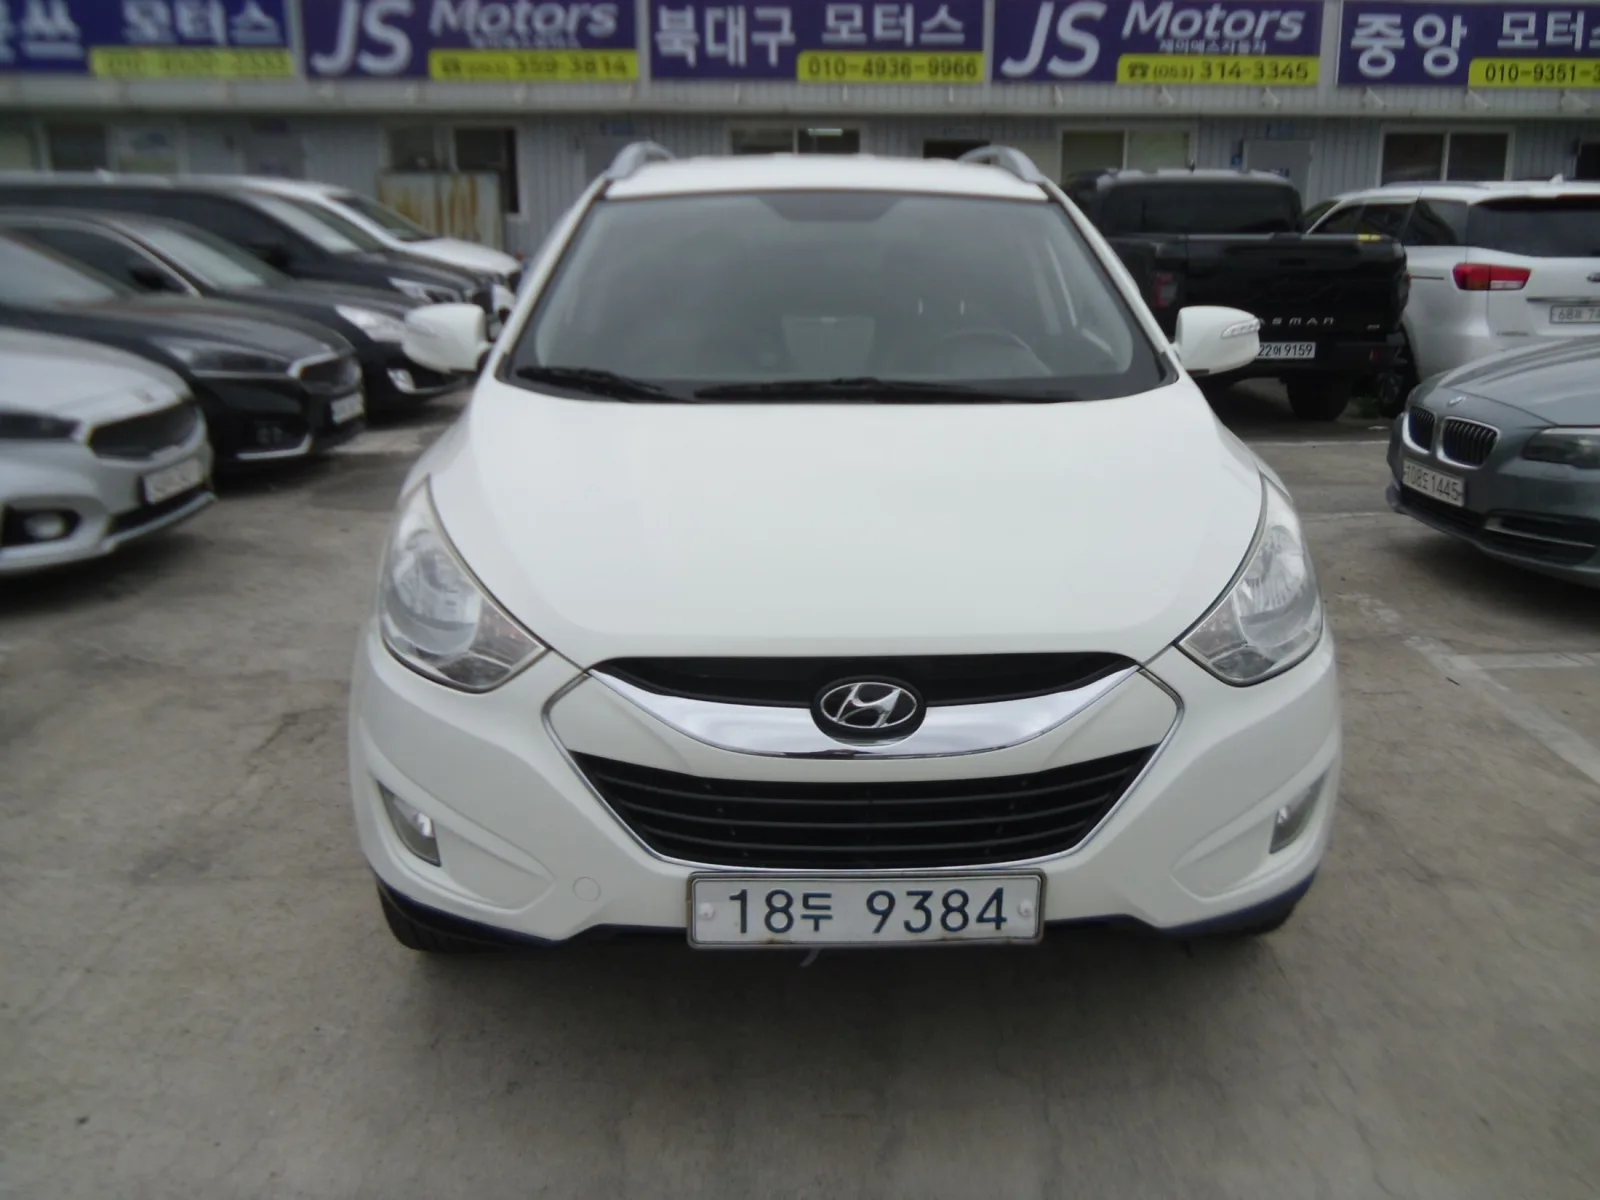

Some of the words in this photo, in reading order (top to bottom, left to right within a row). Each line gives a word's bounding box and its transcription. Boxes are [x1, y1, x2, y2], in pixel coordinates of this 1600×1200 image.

[310, 0, 414, 75] JS
[429, 0, 618, 37] Motors
[655, 5, 796, 67] 북대구
[821, 4, 965, 46] 모터스
[1001, 0, 1108, 77] JS
[1121, 0, 1305, 41] Motors
[1350, 13, 1468, 77] 중앙
[1497, 11, 1600, 51] 모터
[1284, 343, 1314, 356] 9159
[729, 888, 833, 934] 18두
[866, 887, 1007, 934] 9384
